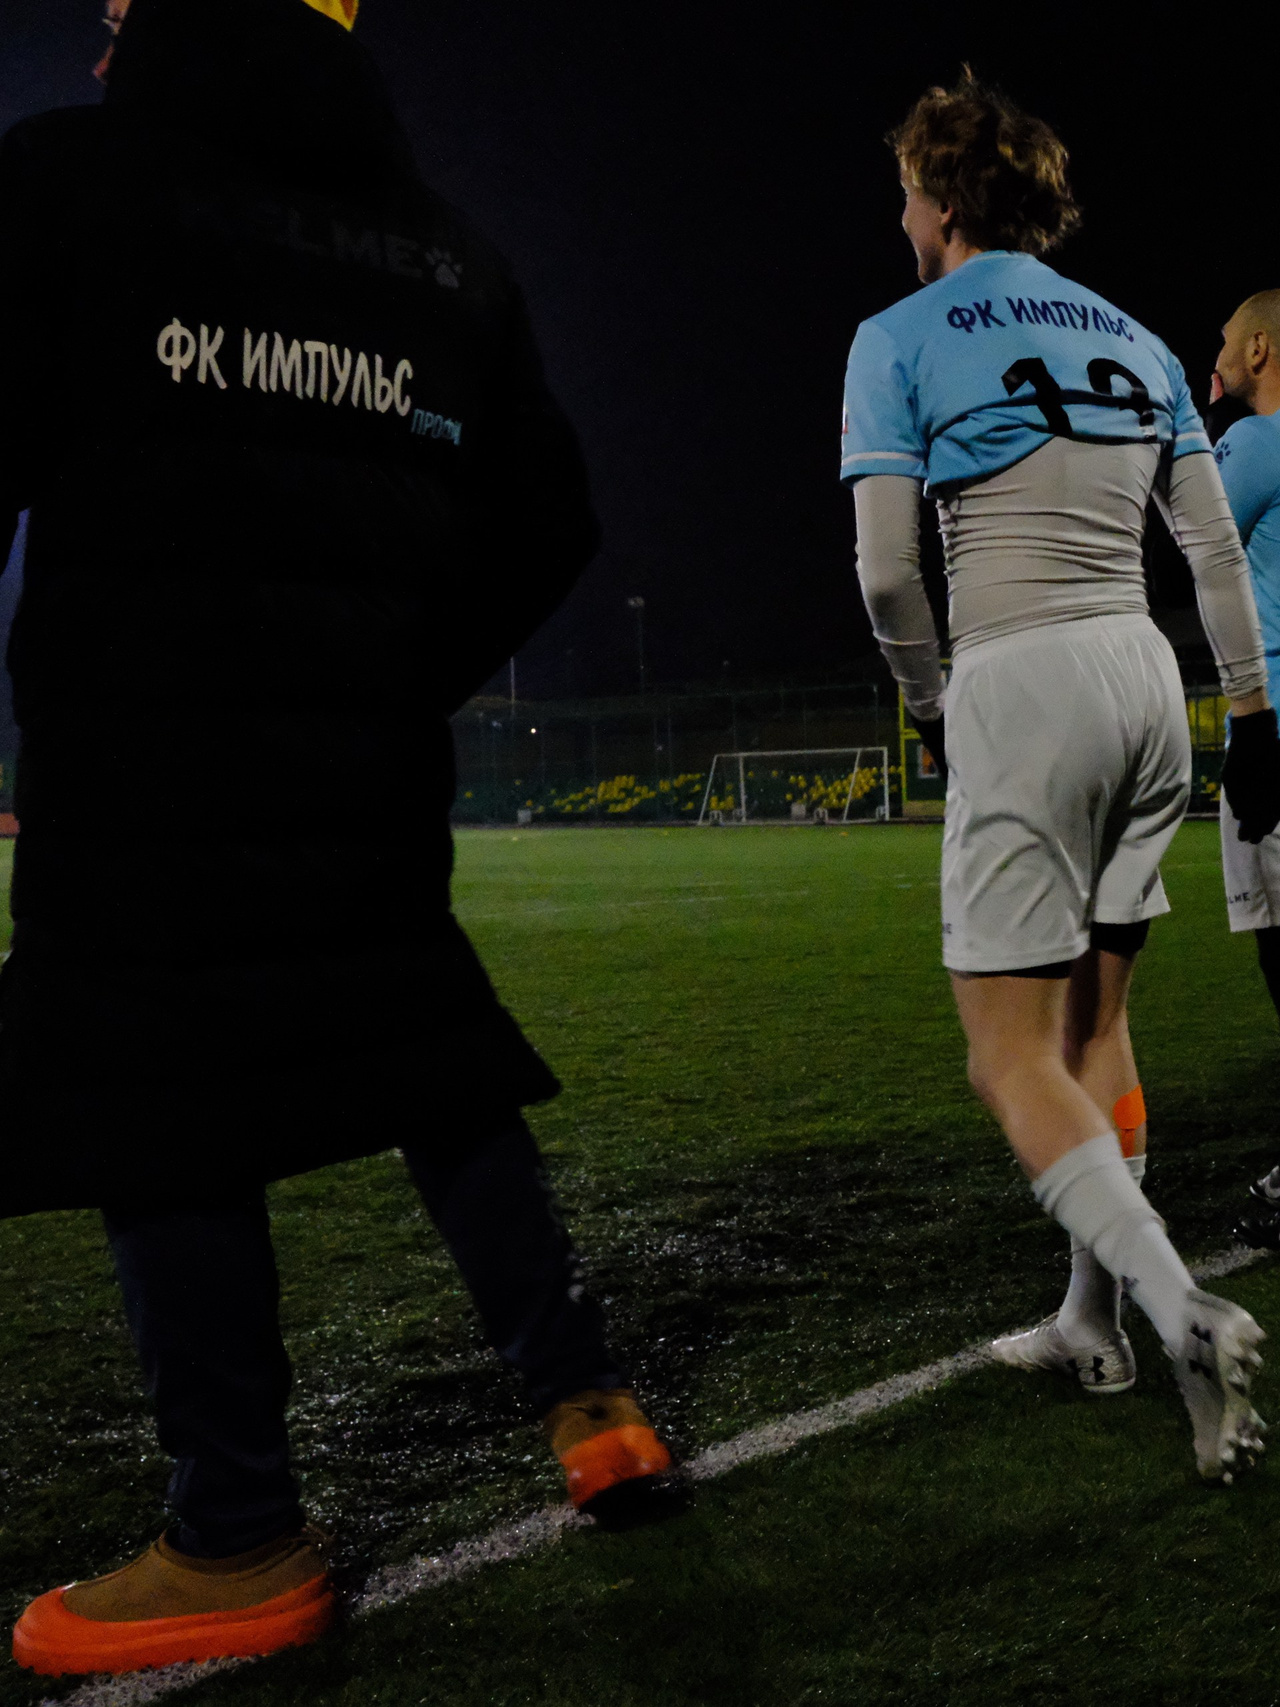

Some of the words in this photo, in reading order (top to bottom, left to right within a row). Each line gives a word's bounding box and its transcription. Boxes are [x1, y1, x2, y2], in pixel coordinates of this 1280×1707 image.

[948, 299, 1006, 334] ФК
[1005, 297, 1135, 343] ИМПУЛЬС
[156, 317, 229, 390] ФК
[242, 326, 414, 417] ИМПУЛЬС
